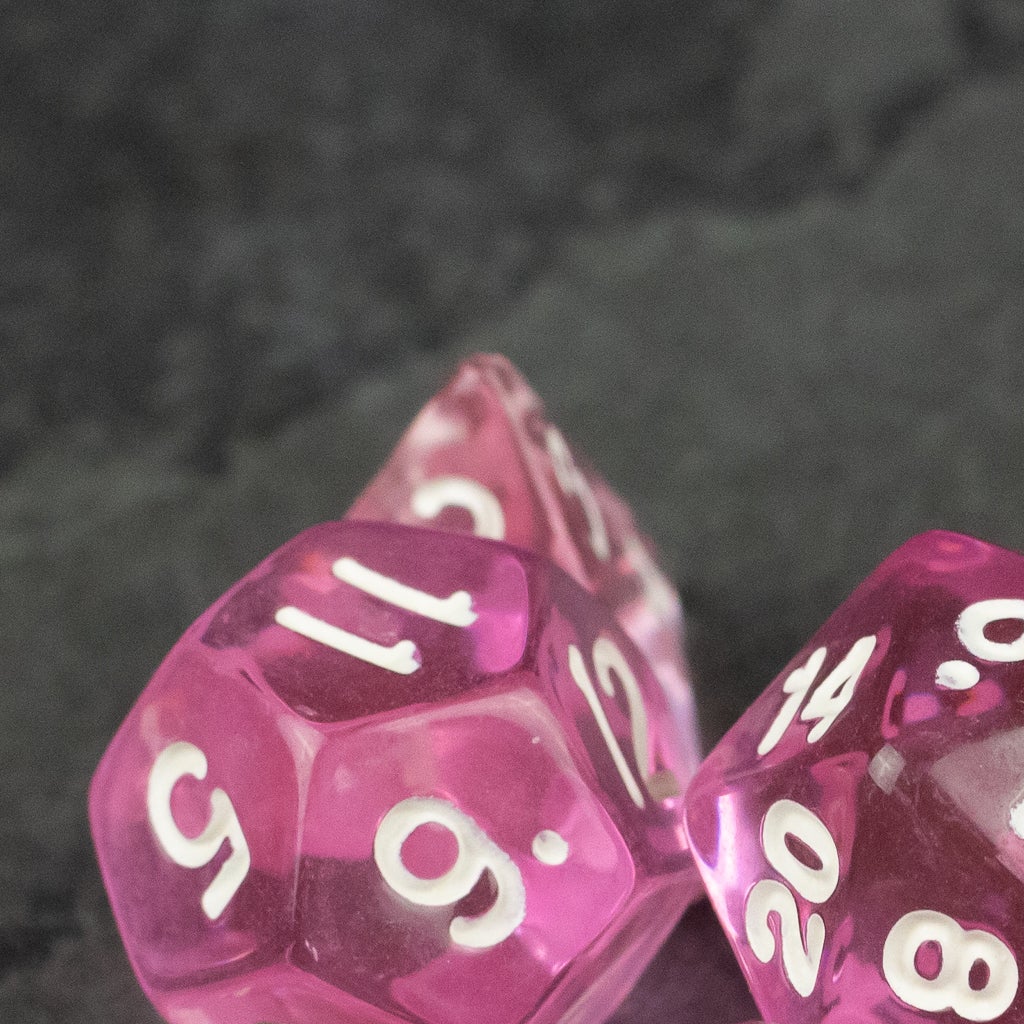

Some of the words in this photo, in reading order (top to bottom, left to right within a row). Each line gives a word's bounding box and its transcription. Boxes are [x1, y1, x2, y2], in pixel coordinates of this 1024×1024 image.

[274, 556, 478, 675] 11
[562, 636, 684, 812] 12
[755, 634, 877, 756] 14
[146, 740, 251, 921] 5
[744, 798, 840, 997] 20
[882, 909, 1020, 1022] 8
